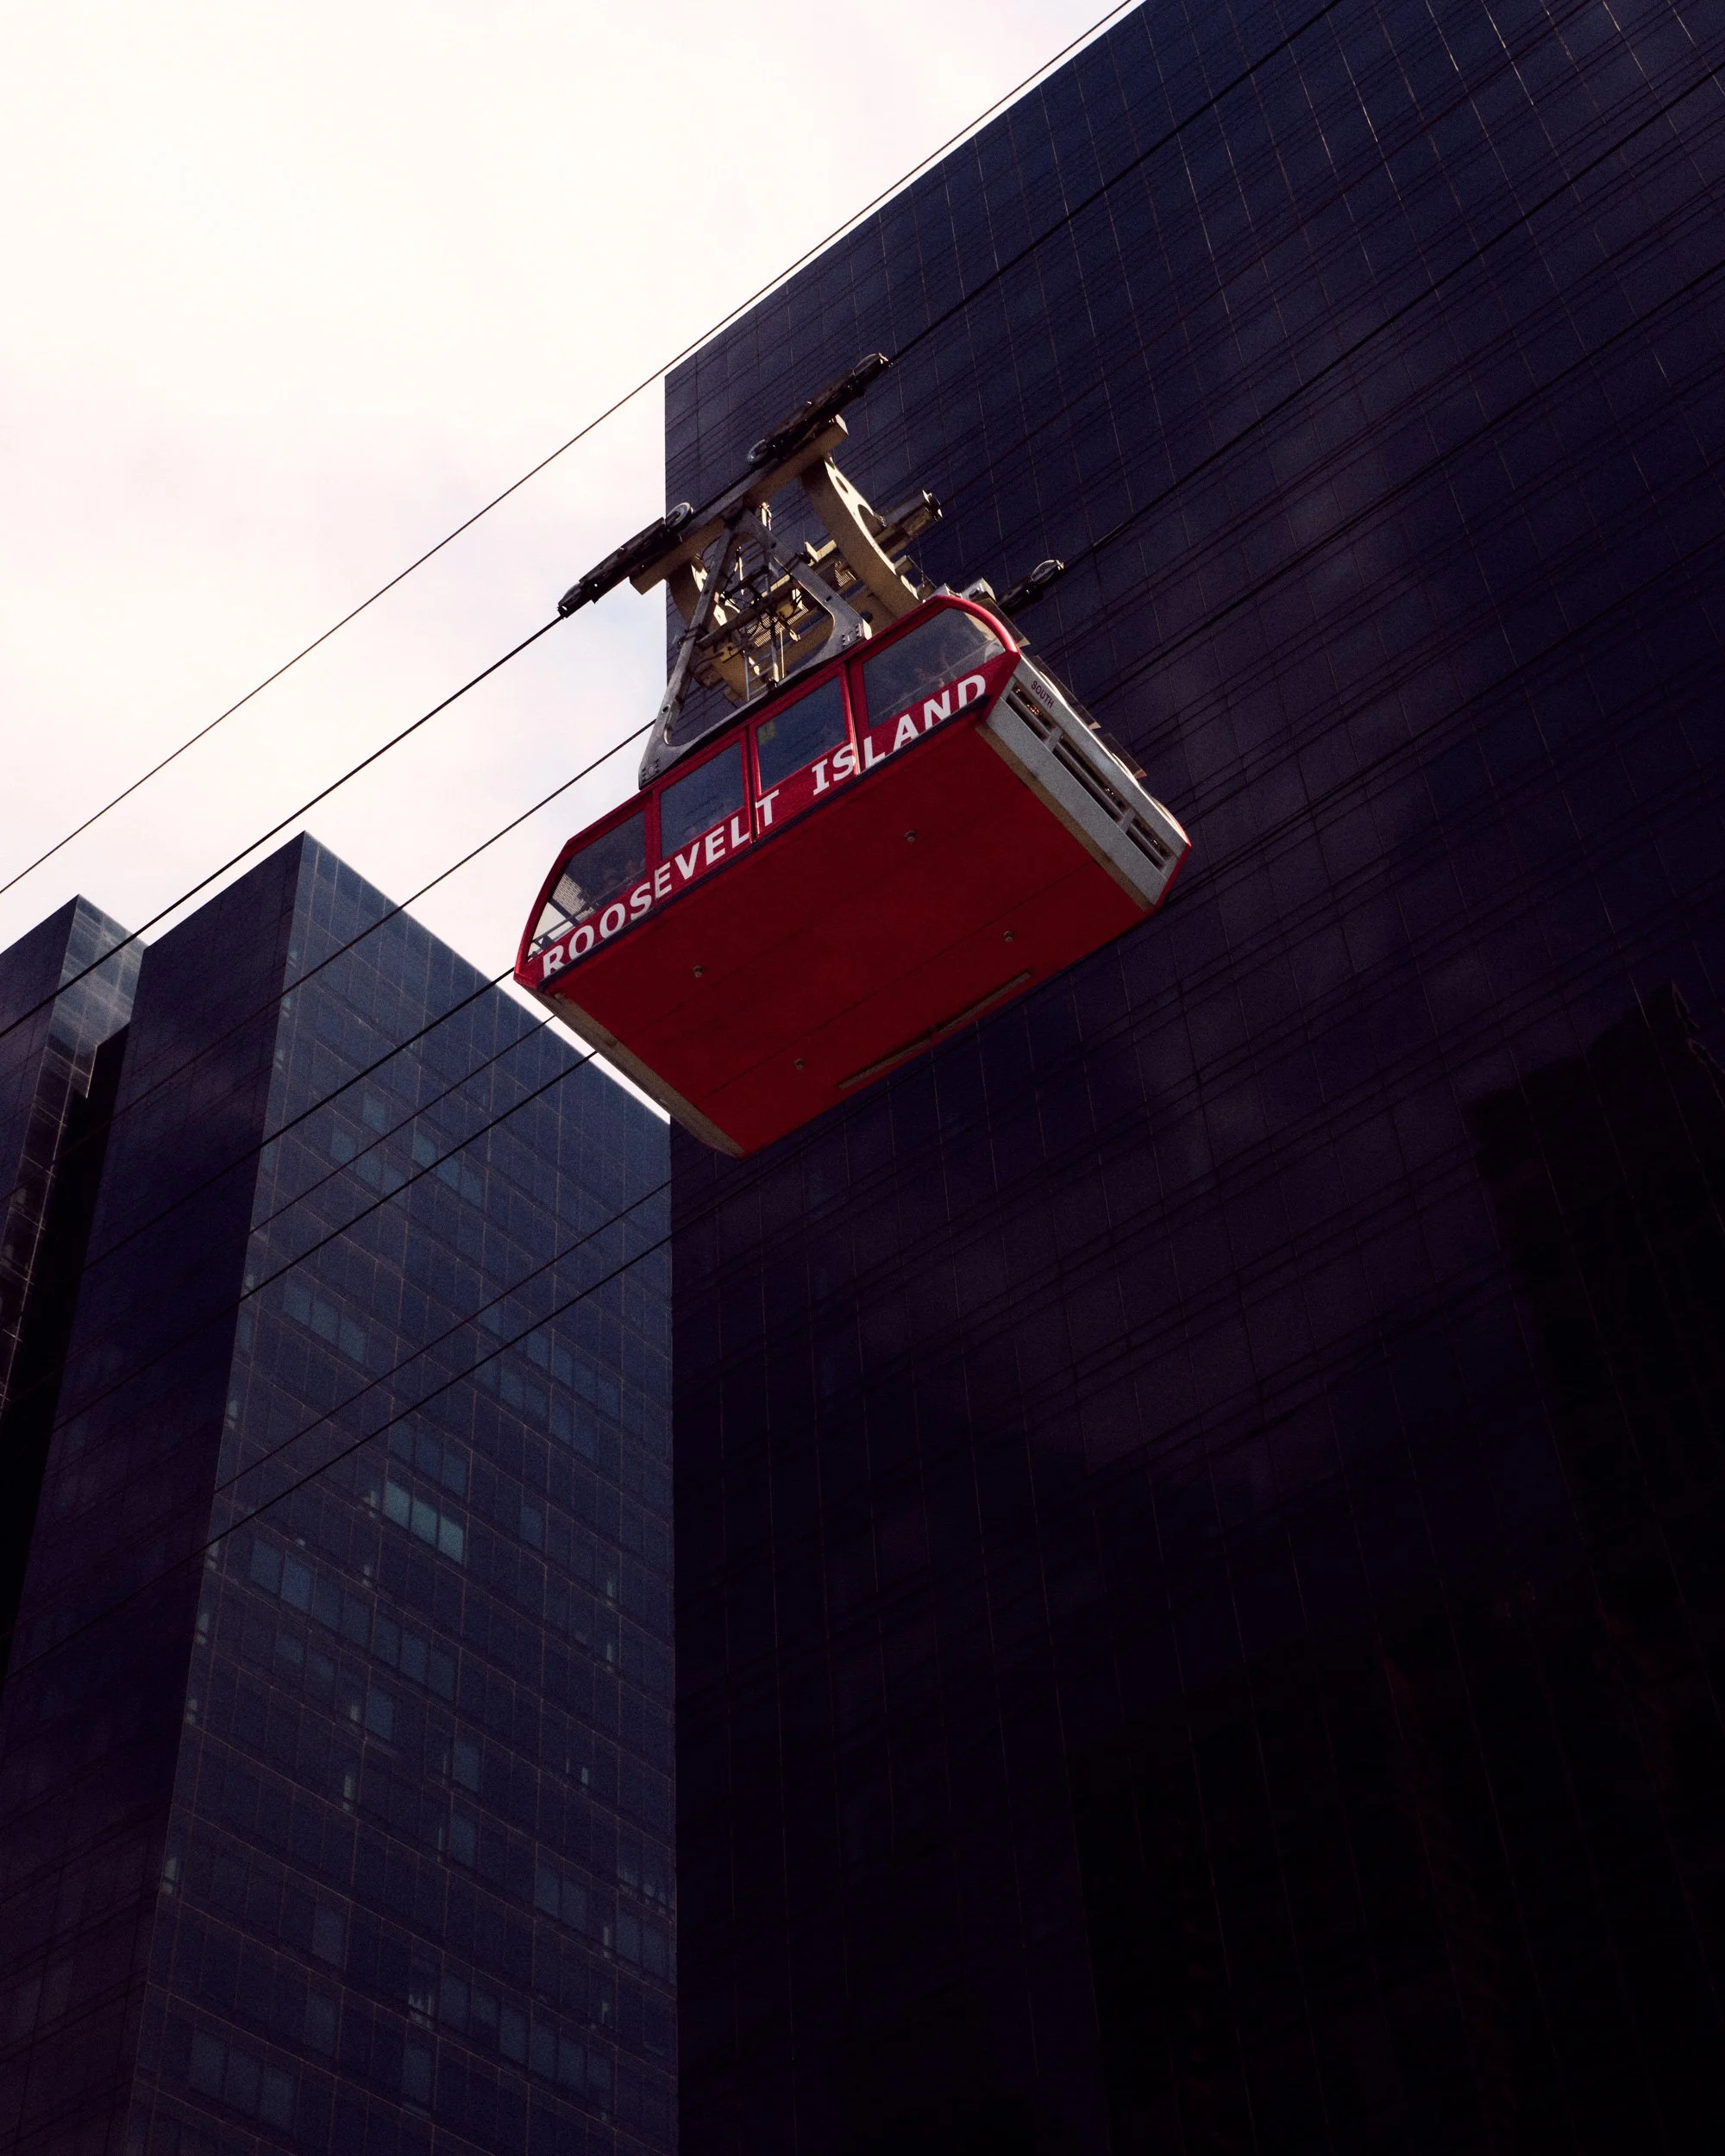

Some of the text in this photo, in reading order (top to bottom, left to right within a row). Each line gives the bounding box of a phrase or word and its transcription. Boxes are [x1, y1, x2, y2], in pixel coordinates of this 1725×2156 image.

[1031, 680, 1054, 708] SOUTH
[543, 674, 986, 978] ROOSEVELT ISLAND
